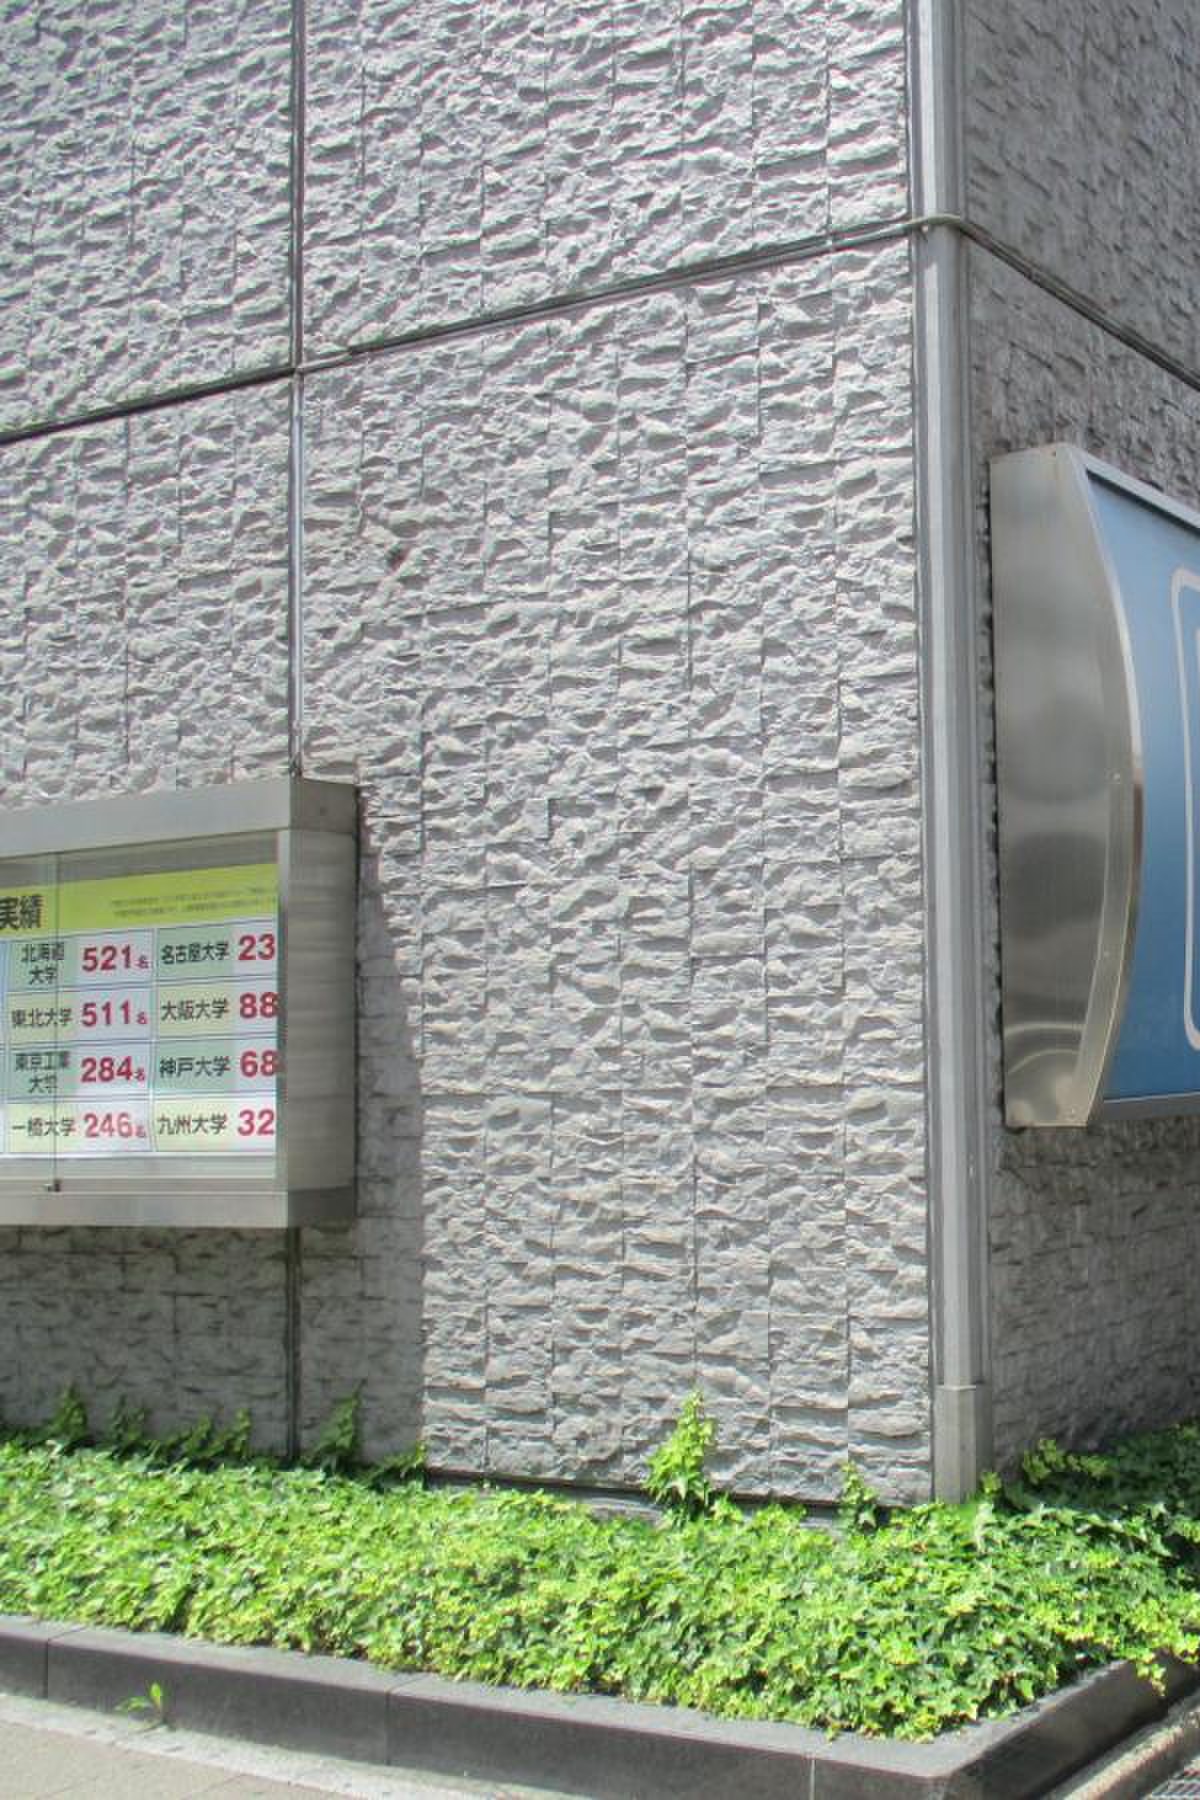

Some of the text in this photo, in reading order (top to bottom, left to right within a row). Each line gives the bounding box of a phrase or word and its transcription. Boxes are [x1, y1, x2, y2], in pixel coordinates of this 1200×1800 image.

[160, 942, 230, 966] 名古屋大学
[28, 965, 58, 985] 大学
[11, 1007, 73, 1029] 東北大学
[160, 998, 229, 1021] 大阪大学
[159, 1055, 230, 1079] 神戸大学
[28, 1074, 58, 1094] 大学
[12, 1115, 76, 1138] 一橋大学
[157, 1111, 228, 1136] 九州大学
